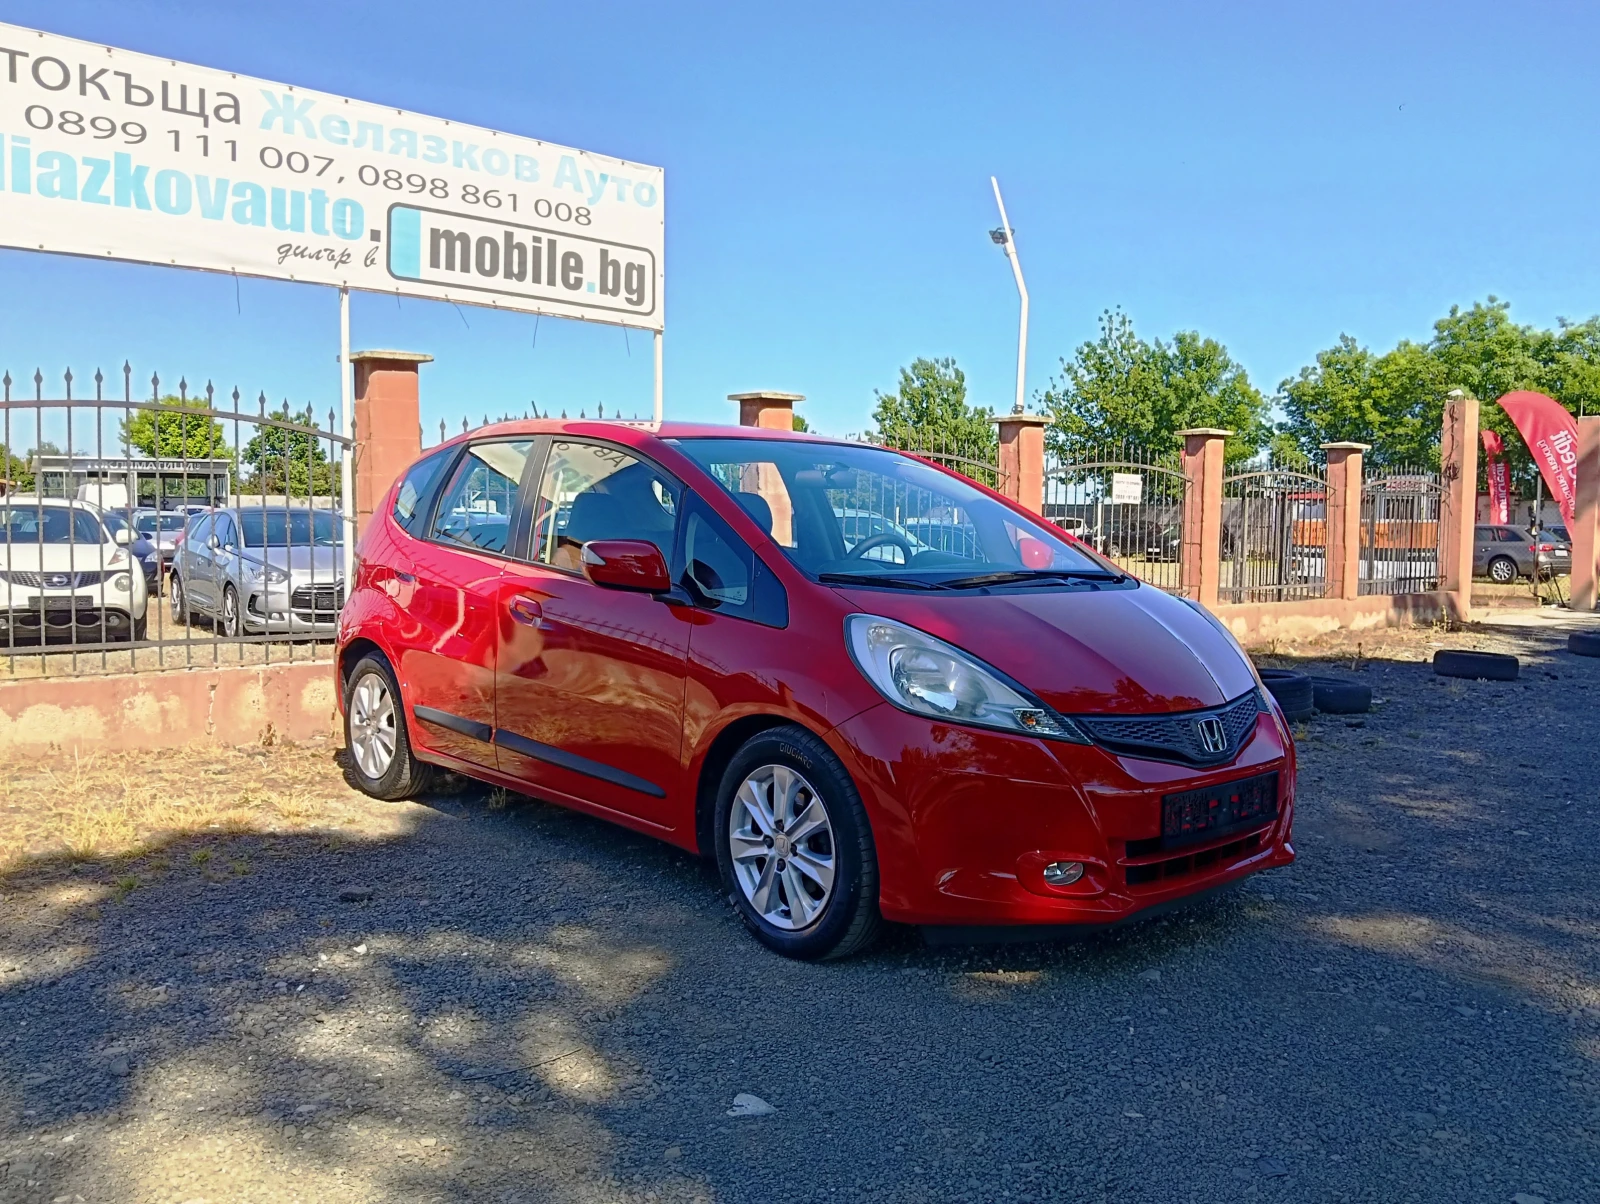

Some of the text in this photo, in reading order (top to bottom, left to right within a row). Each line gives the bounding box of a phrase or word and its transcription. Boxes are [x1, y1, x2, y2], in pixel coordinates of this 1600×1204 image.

[24, 104, 593, 226] 0899 111 007, 0898 861 008
[258, 88, 540, 183] Желязков
[553, 155, 658, 208] Ауто
[0, 132, 646, 307] iazkovauto. mobile.bg
